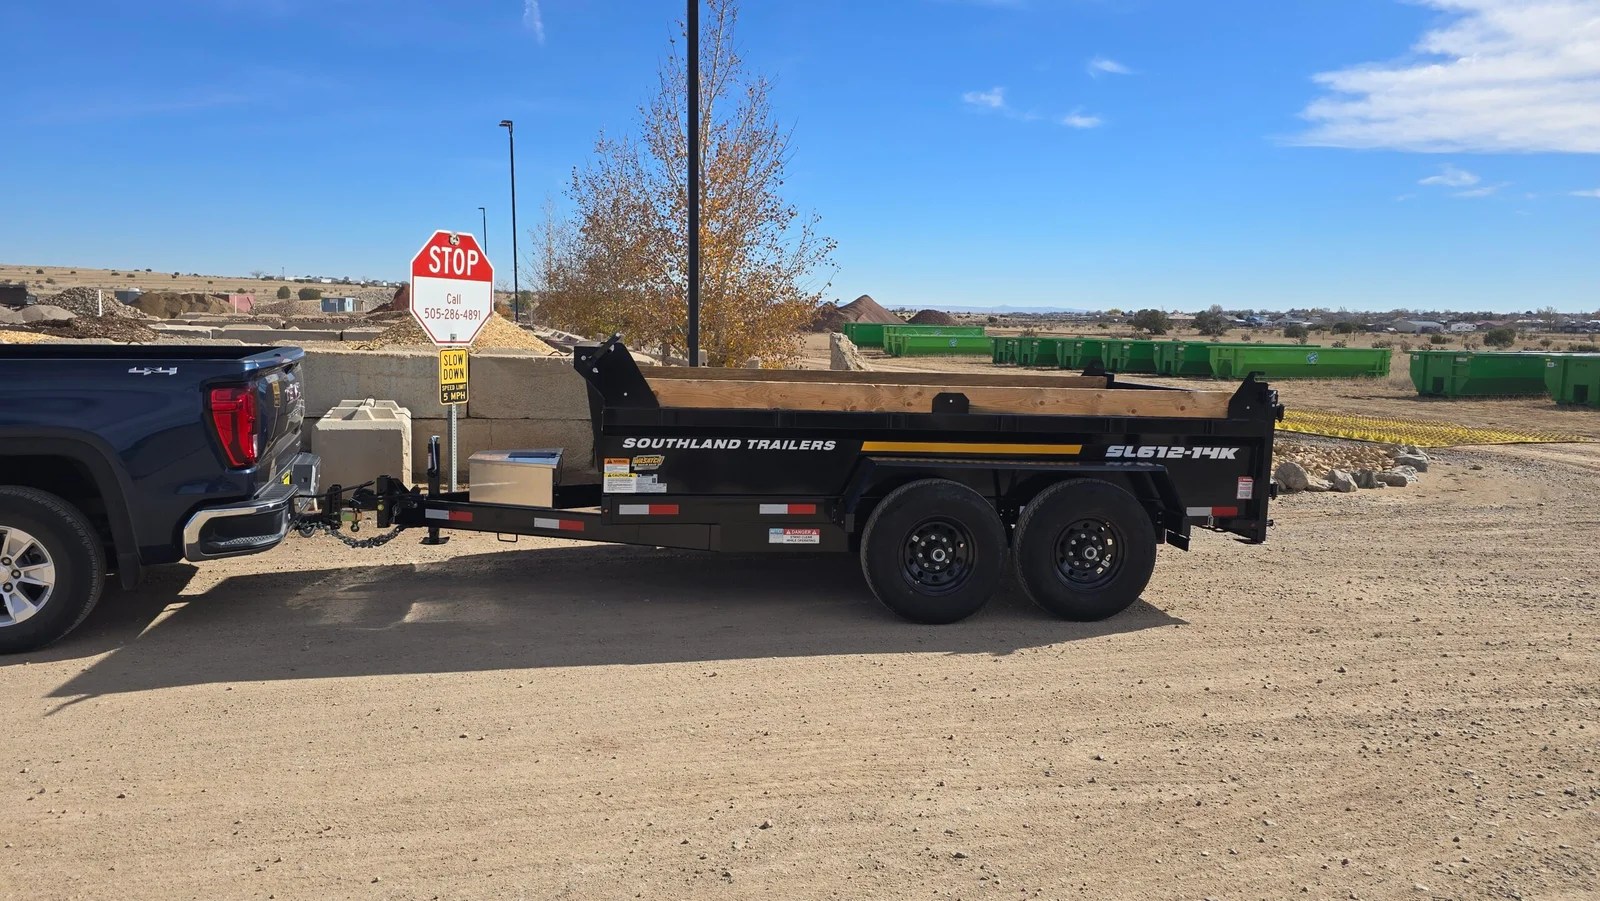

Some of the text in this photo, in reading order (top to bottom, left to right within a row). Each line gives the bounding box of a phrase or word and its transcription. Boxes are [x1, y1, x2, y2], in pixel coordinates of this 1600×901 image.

[428, 245, 479, 276] STOP
[446, 293, 462, 305] Call
[424, 307, 481, 321] 505-286-4891
[443, 354, 464, 367] SLOW
[443, 368, 465, 380] DOWN
[441, 383, 467, 392] SPEED LIMIT
[443, 391, 466, 401] 5 MPH
[622, 437, 837, 451] SOUTHLAND TRAILERS
[1105, 445, 1240, 460] SL612-14K
